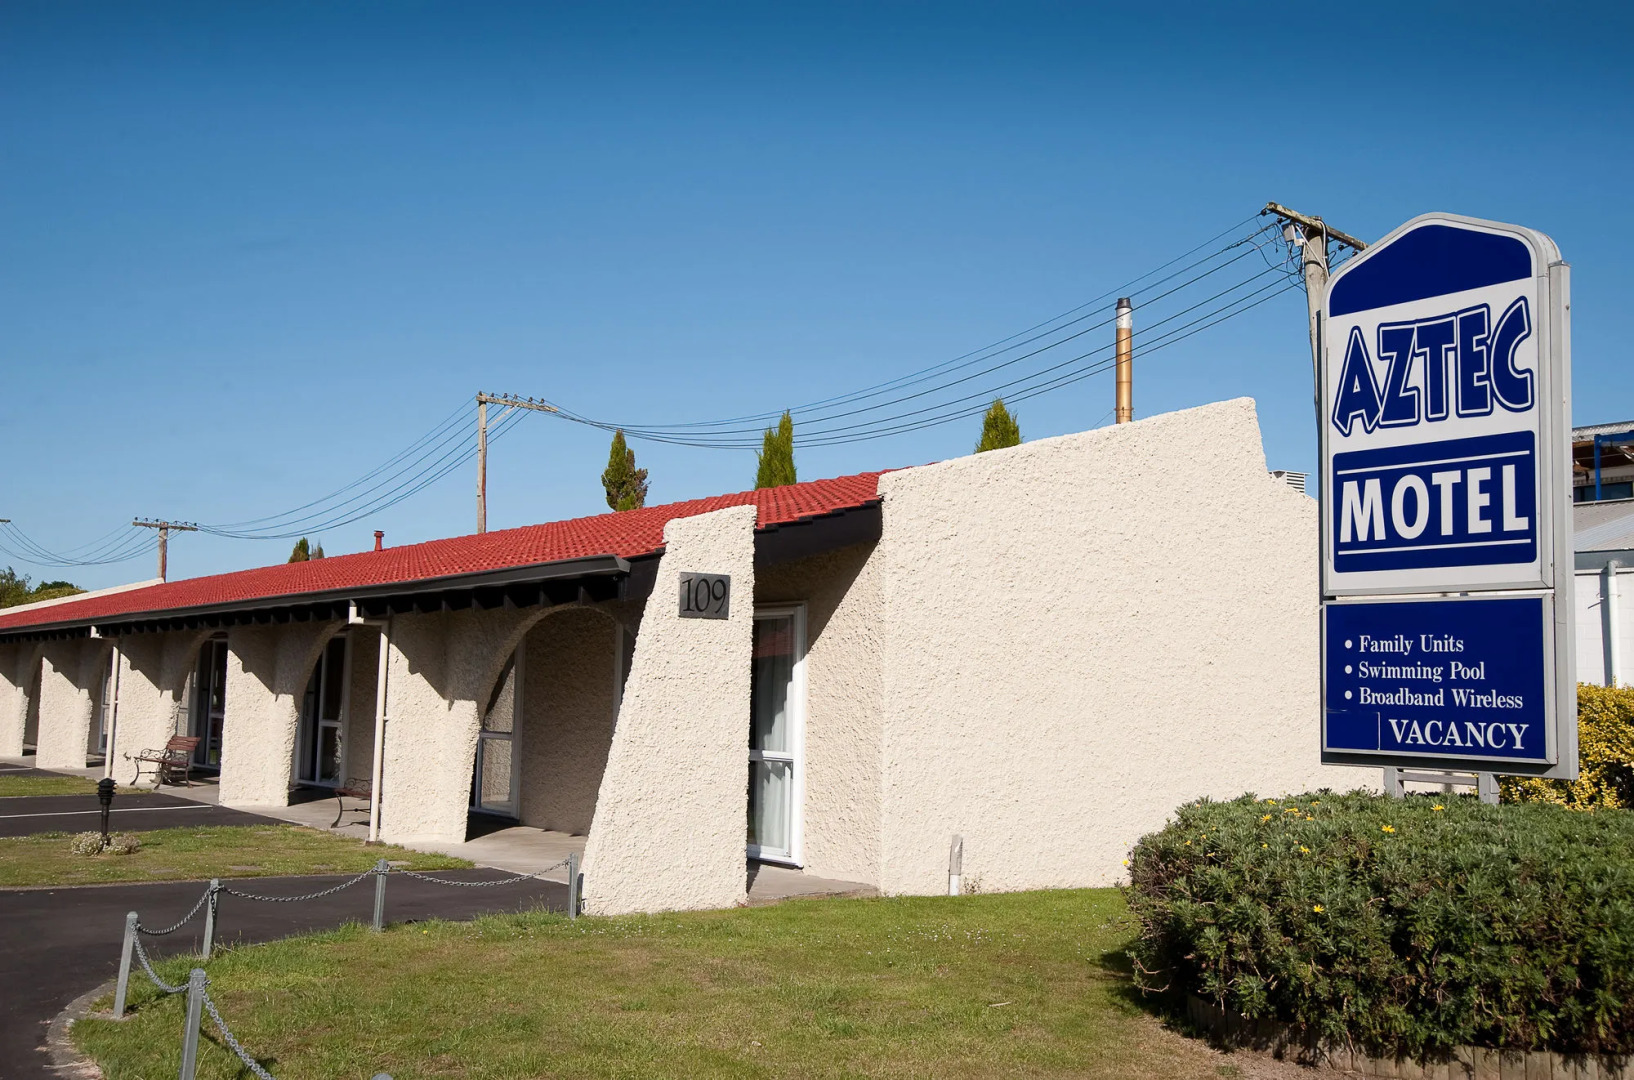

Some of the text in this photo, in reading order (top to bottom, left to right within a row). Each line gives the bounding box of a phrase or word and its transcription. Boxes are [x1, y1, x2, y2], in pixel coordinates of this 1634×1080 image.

[1332, 295, 1534, 437] AZTEC
[1340, 464, 1529, 543] MOTEL
[682, 578, 726, 613] 109
[1359, 634, 1464, 655] Family Units
[1358, 661, 1485, 682] Swimming Pool
[1359, 687, 1523, 709] Broadband Wireless
[1389, 719, 1529, 749] VACANCY
